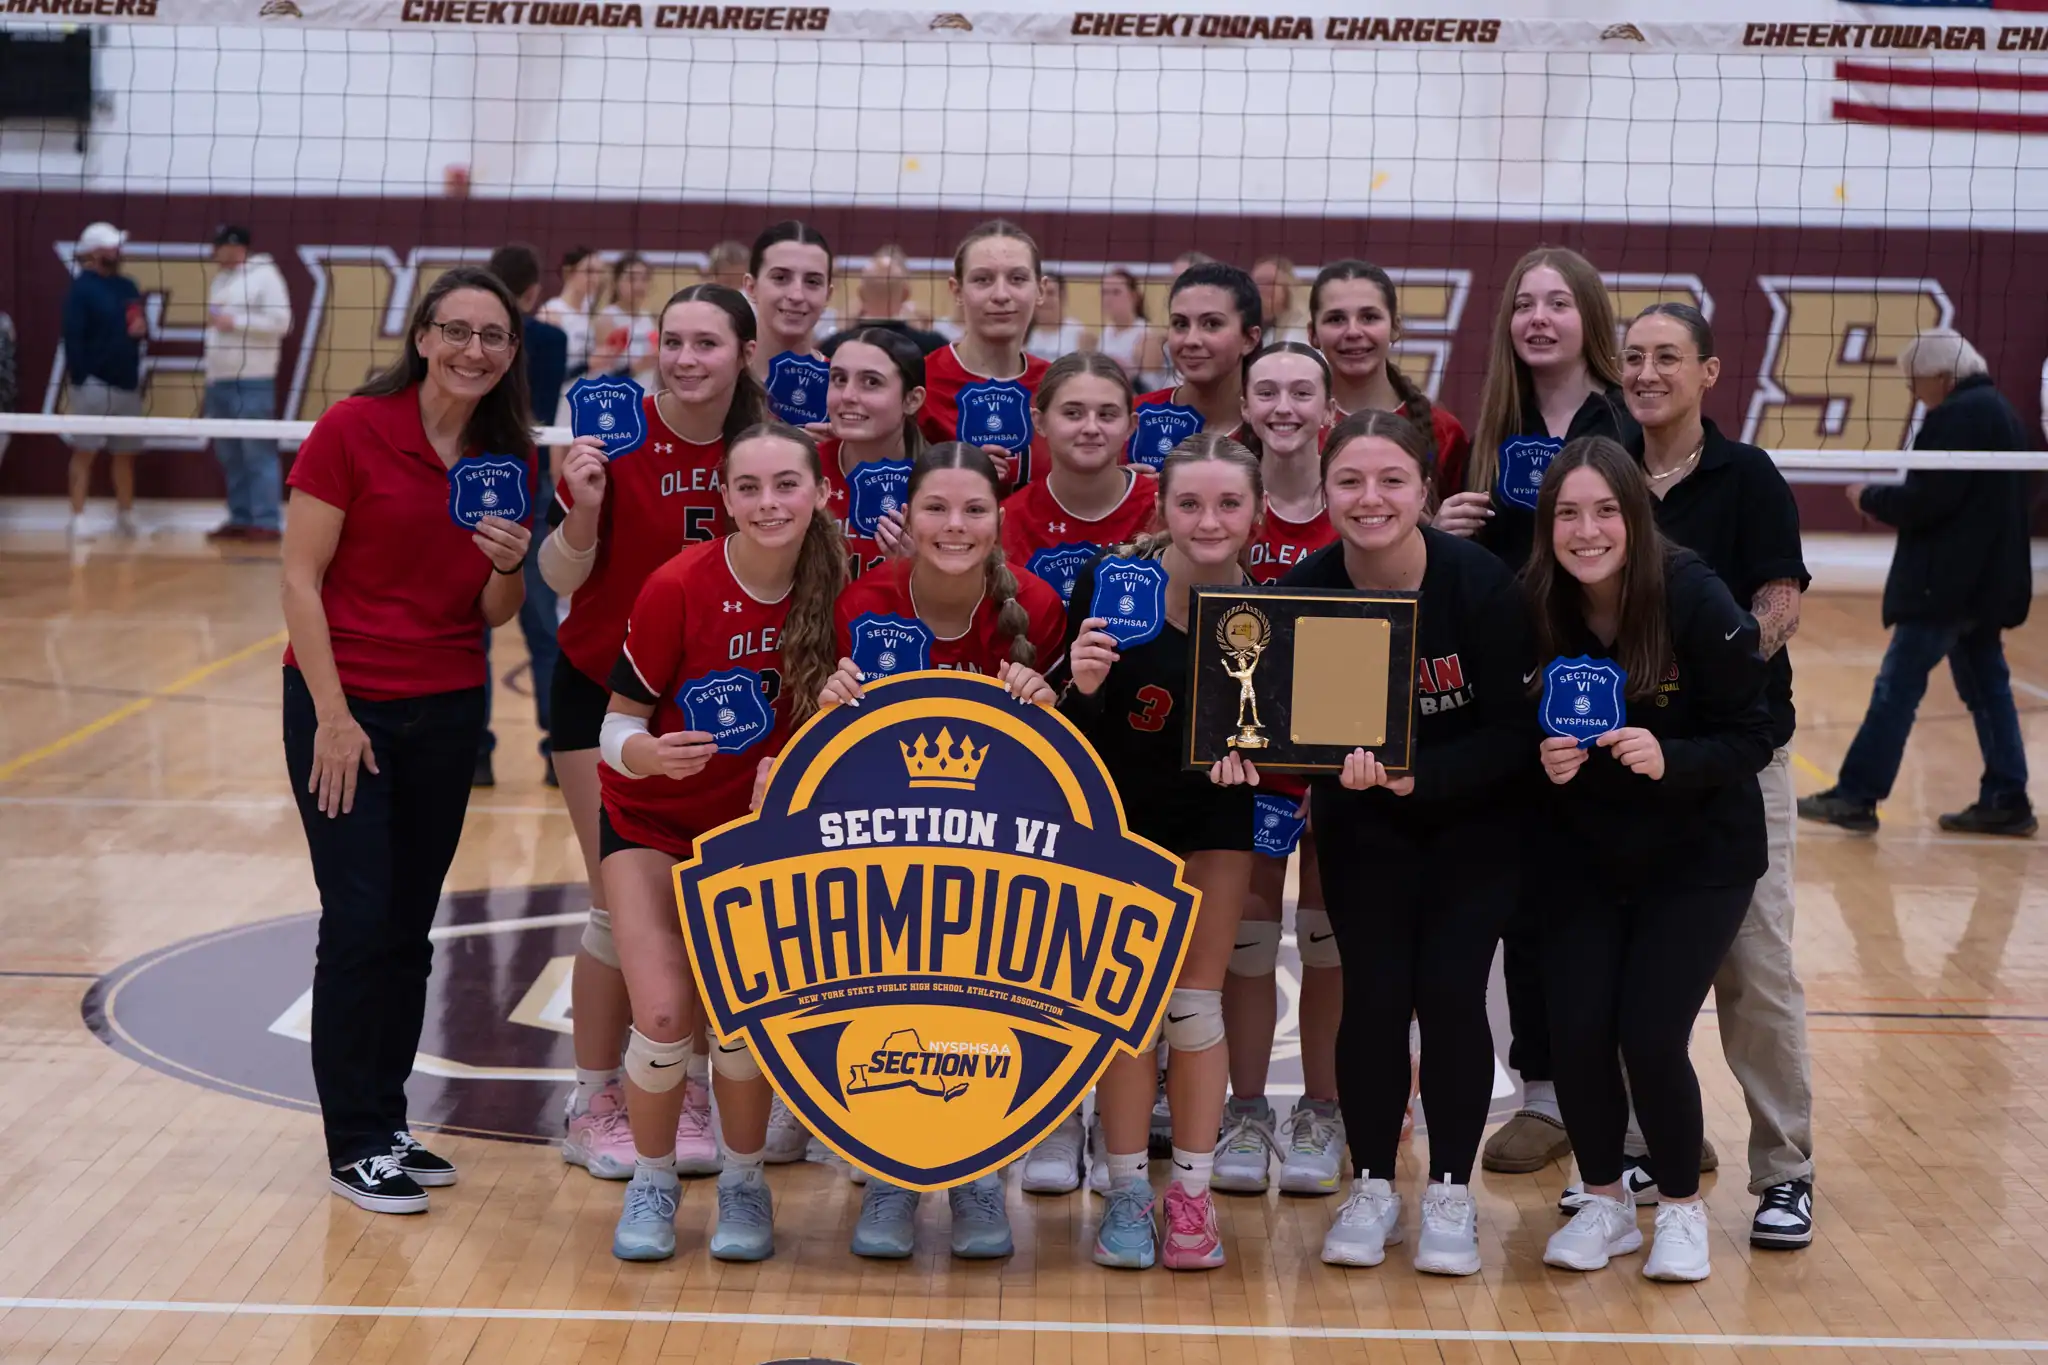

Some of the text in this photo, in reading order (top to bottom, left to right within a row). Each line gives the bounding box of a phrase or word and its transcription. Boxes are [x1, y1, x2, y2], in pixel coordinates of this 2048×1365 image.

[401, 0, 831, 31] CHEEKTOWAGA CHARGERS
[1071, 13, 1501, 43] CHEEKTOWAGA CHARGERS
[1743, 23, 2048, 50] CHEEKTOWAGA CH
[784, 366, 825, 384] SECTION
[798, 375, 810, 387] VI
[583, 390, 627, 403] SECTION
[971, 393, 1014, 405] SECTION
[599, 399, 612, 409] VI
[987, 402, 999, 412] VI
[1145, 415, 1188, 428] SECTION
[1160, 424, 1173, 434] VI
[971, 433, 1018, 442] NYSPHSAA
[1531, 456, 1543, 466] VI
[465, 468, 511, 482] SECTION
[864, 473, 909, 486] SECTION
[482, 477, 495, 487] VI
[661, 468, 721, 497] OLEA
[881, 481, 894, 492] VI
[465, 508, 516, 518] NYSPHSAA
[1249, 542, 1316, 566] OLEA
[1044, 556, 1088, 573] SECTION
[1060, 565, 1074, 577] VI
[1109, 571, 1152, 586] SECTION
[1124, 581, 1136, 593] VI
[866, 628, 915, 644] SECTION
[883, 637, 897, 649] VI
[1559, 671, 1607, 685] SECTION
[1576, 681, 1590, 692] VI
[695, 684, 743, 704] SECTION
[713, 693, 729, 705] VI
[1128, 684, 1173, 732] 3
[1555, 717, 1608, 727] NYSPHSAA
[713, 721, 759, 740] YSPHSAA
[819, 807, 1061, 858] SECTION VI
[713, 864, 1159, 1016] CHAMPIONS
[798, 983, 1064, 1016] NEW YORK STATE PUBLIC HIGH SCHOOL ATHLETIC ASSOCIATION
[929, 1041, 1011, 1055] NYSPHSAA
[868, 1050, 1011, 1078] SECTION VI
